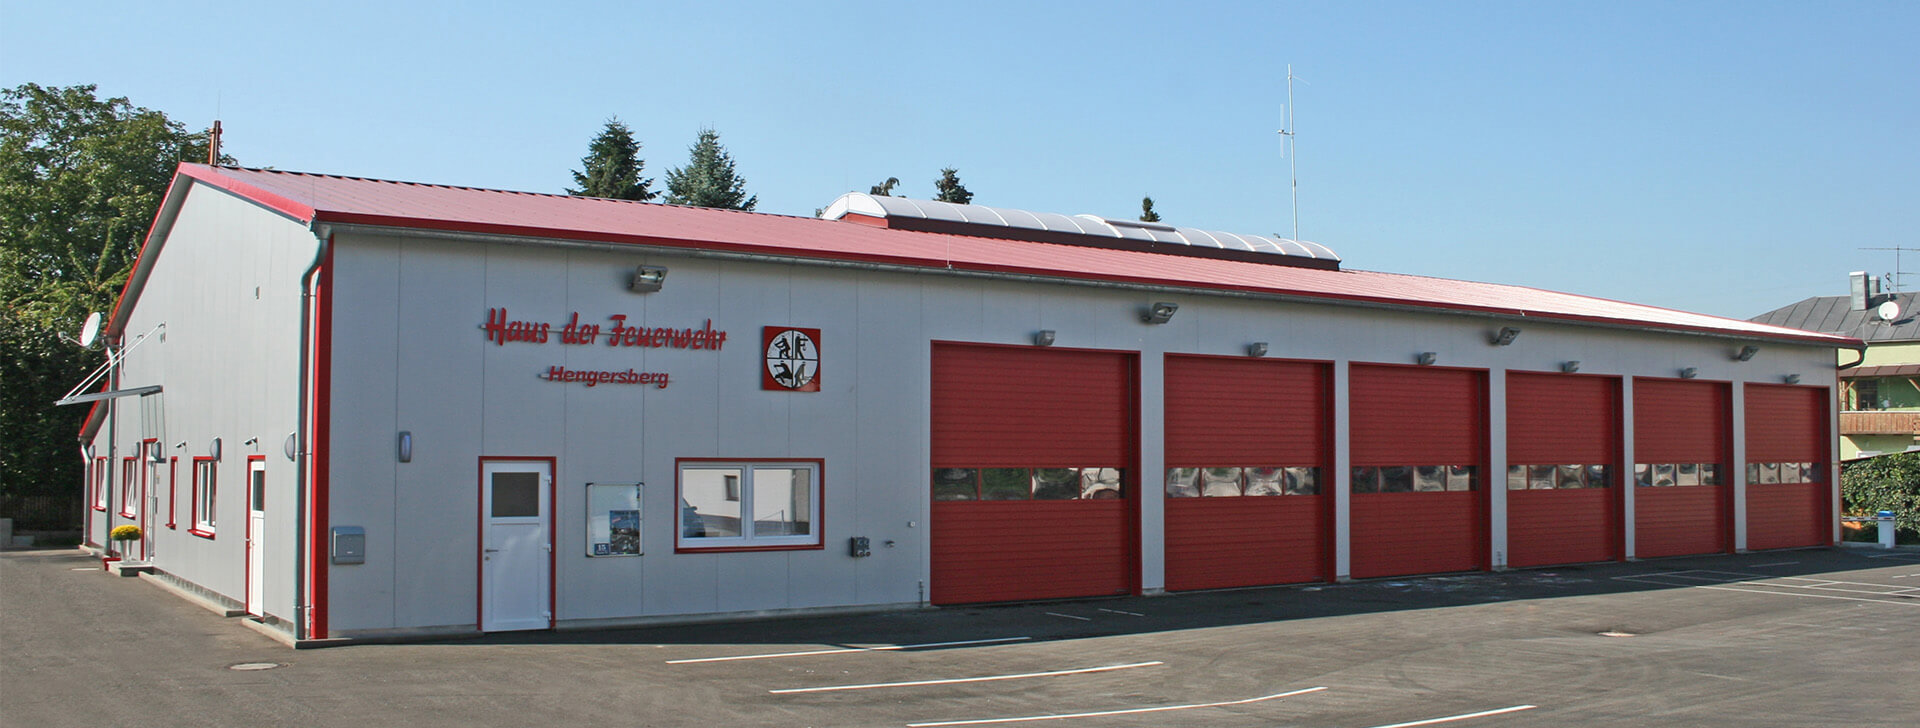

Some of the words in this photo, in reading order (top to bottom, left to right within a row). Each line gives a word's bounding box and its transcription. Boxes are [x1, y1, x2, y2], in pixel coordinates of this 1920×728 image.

[486, 307, 550, 346] Haus
[562, 311, 600, 345] der
[609, 314, 727, 350] Feuerwehr
[549, 366, 669, 388] Hengersberg
